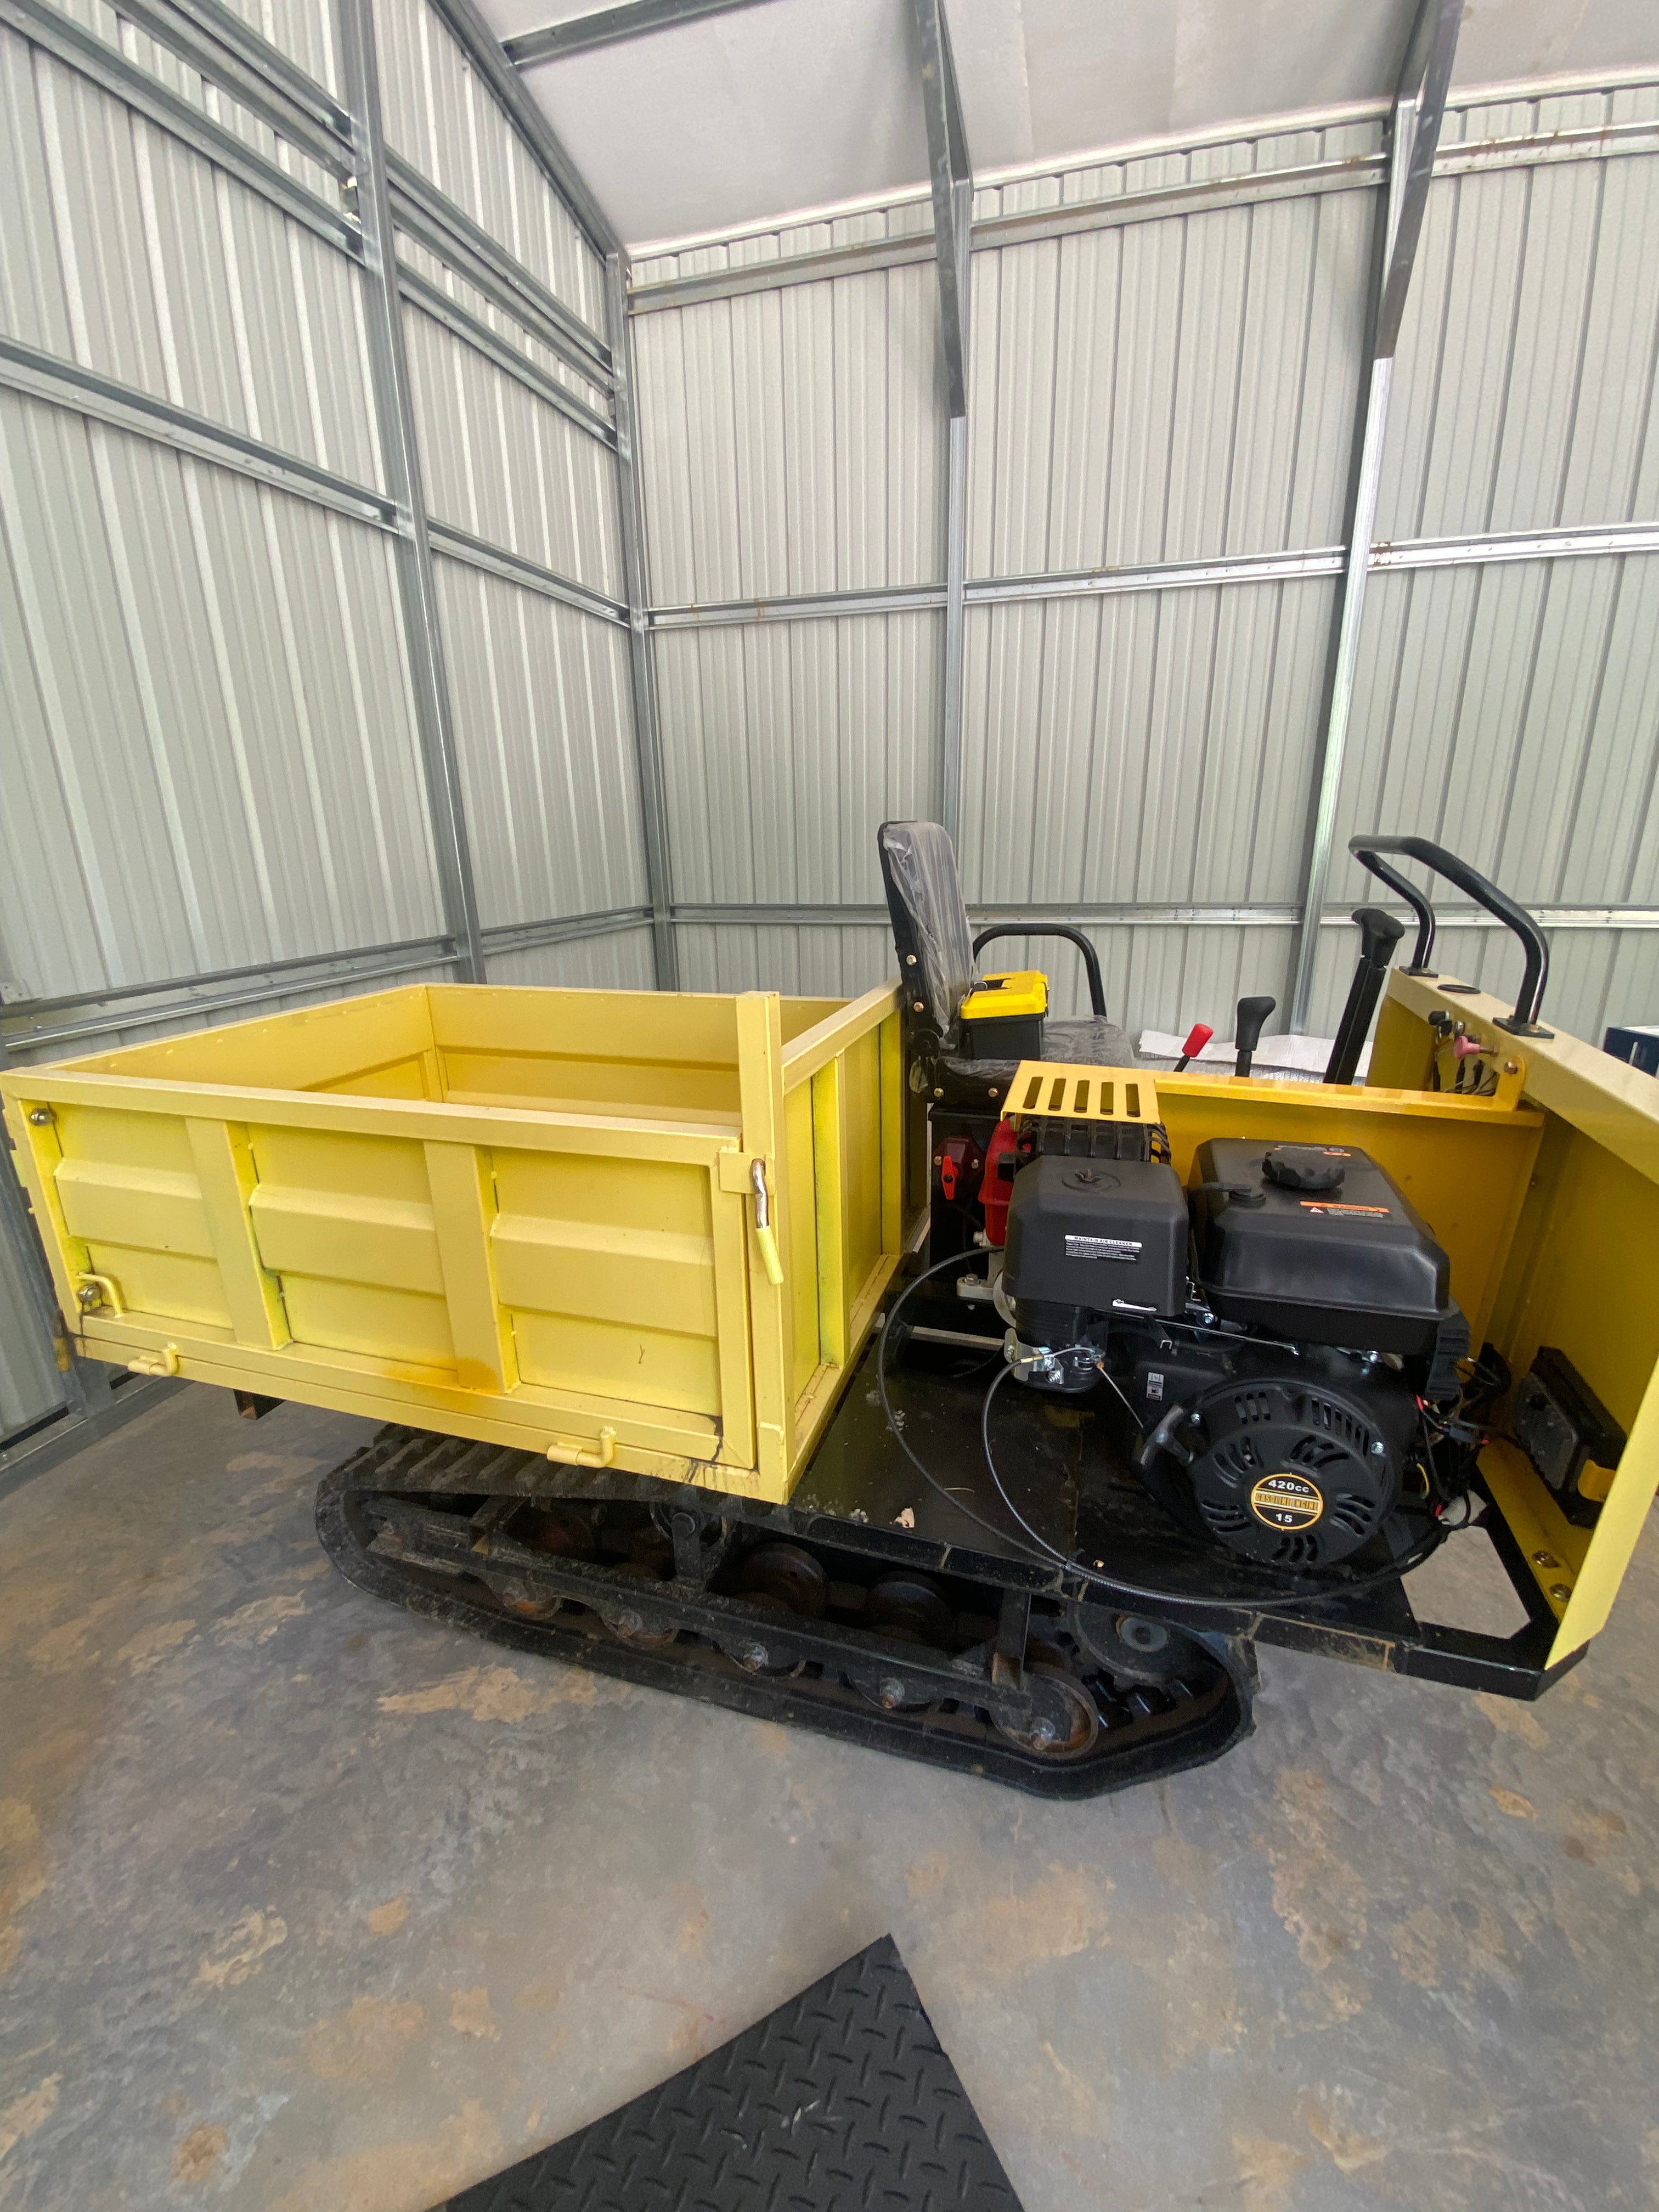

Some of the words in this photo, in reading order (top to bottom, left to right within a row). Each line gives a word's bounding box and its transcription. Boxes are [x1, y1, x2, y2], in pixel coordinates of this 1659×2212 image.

[1268, 1480, 1310, 1493] 420cc
[1255, 1492, 1291, 1506] GASOLINE
[1290, 1498, 1318, 1511] ENGINE
[1276, 1513, 1293, 1523] 15
